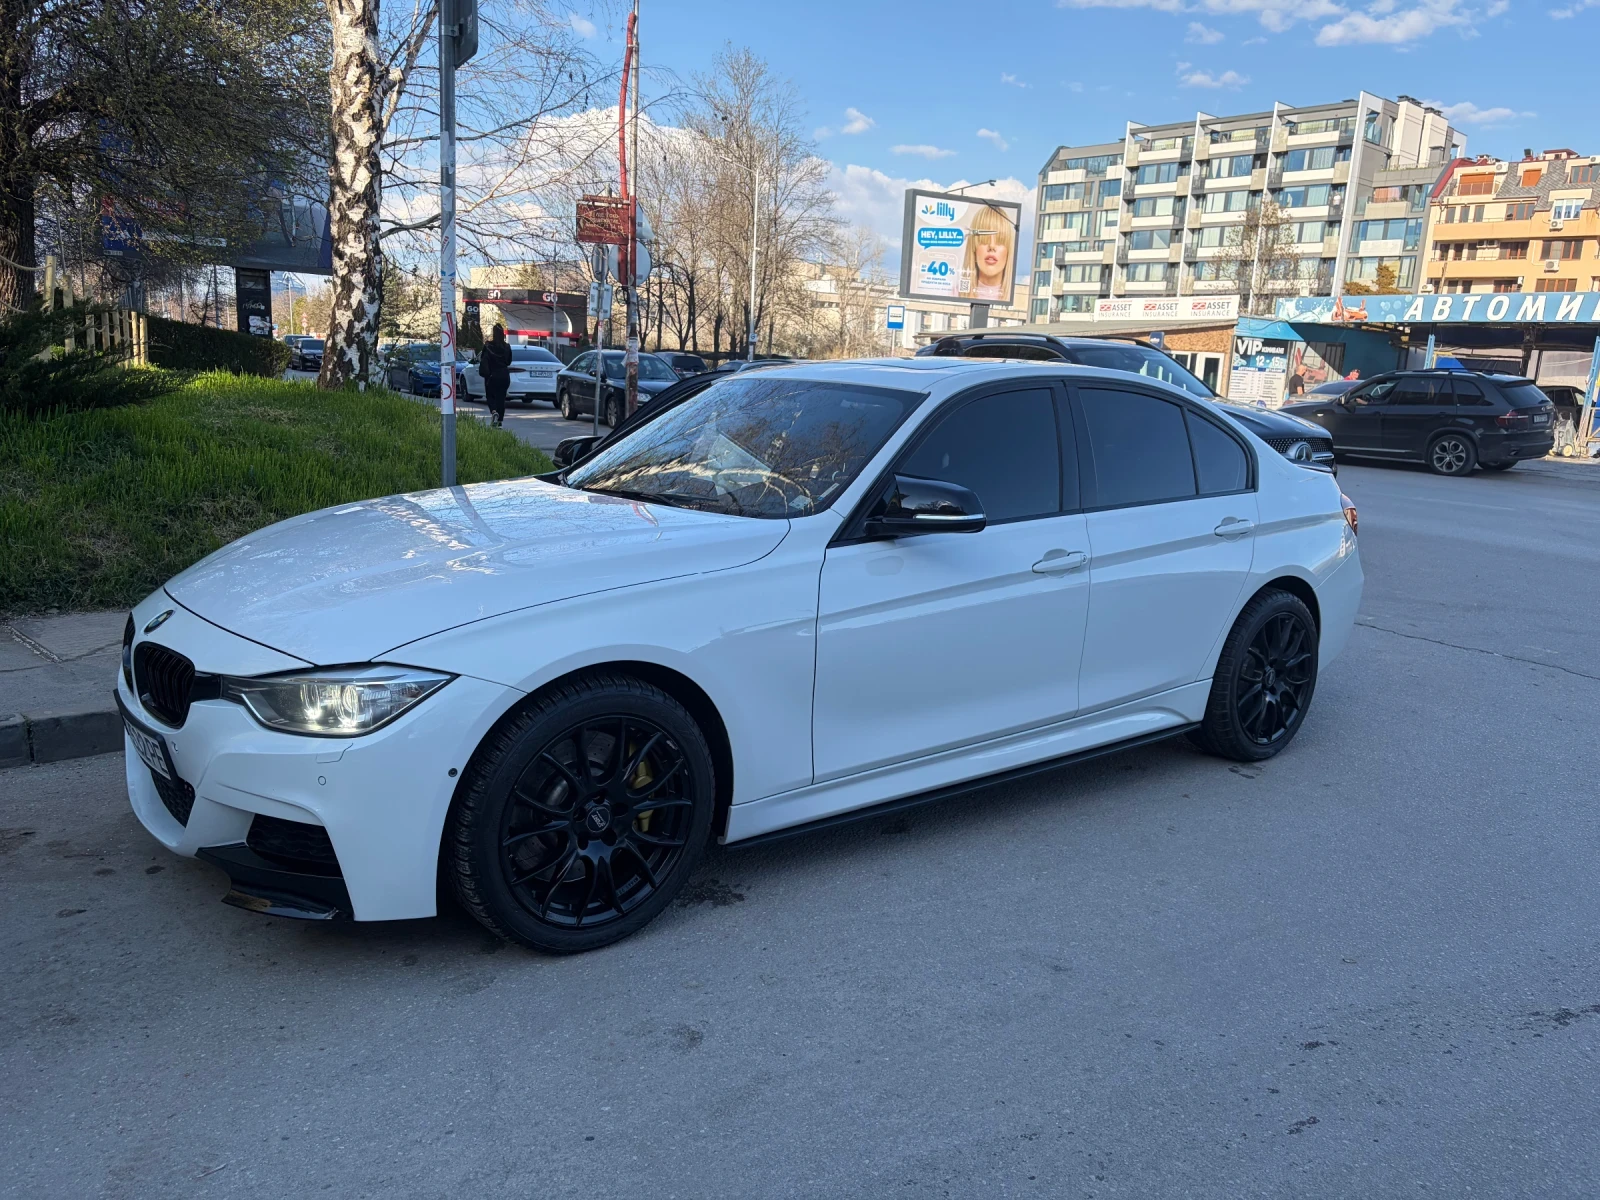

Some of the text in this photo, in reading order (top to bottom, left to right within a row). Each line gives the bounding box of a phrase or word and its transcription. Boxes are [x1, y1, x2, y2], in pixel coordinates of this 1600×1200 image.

[936, 202, 955, 221] lilly
[921, 230, 937, 240] HEY,
[542, 292, 558, 302] GO
[466, 305, 479, 313] GO
[1112, 303, 1132, 311] ASSET
[1157, 302, 1179, 311] ASSET
[1206, 301, 1231, 310] ASSET
[1142, 310, 1179, 318] INSURANCE
[1190, 309, 1231, 317] INSURANCE
[1236, 339, 1263, 356] VIP
[1256, 355, 1265, 367] 12
